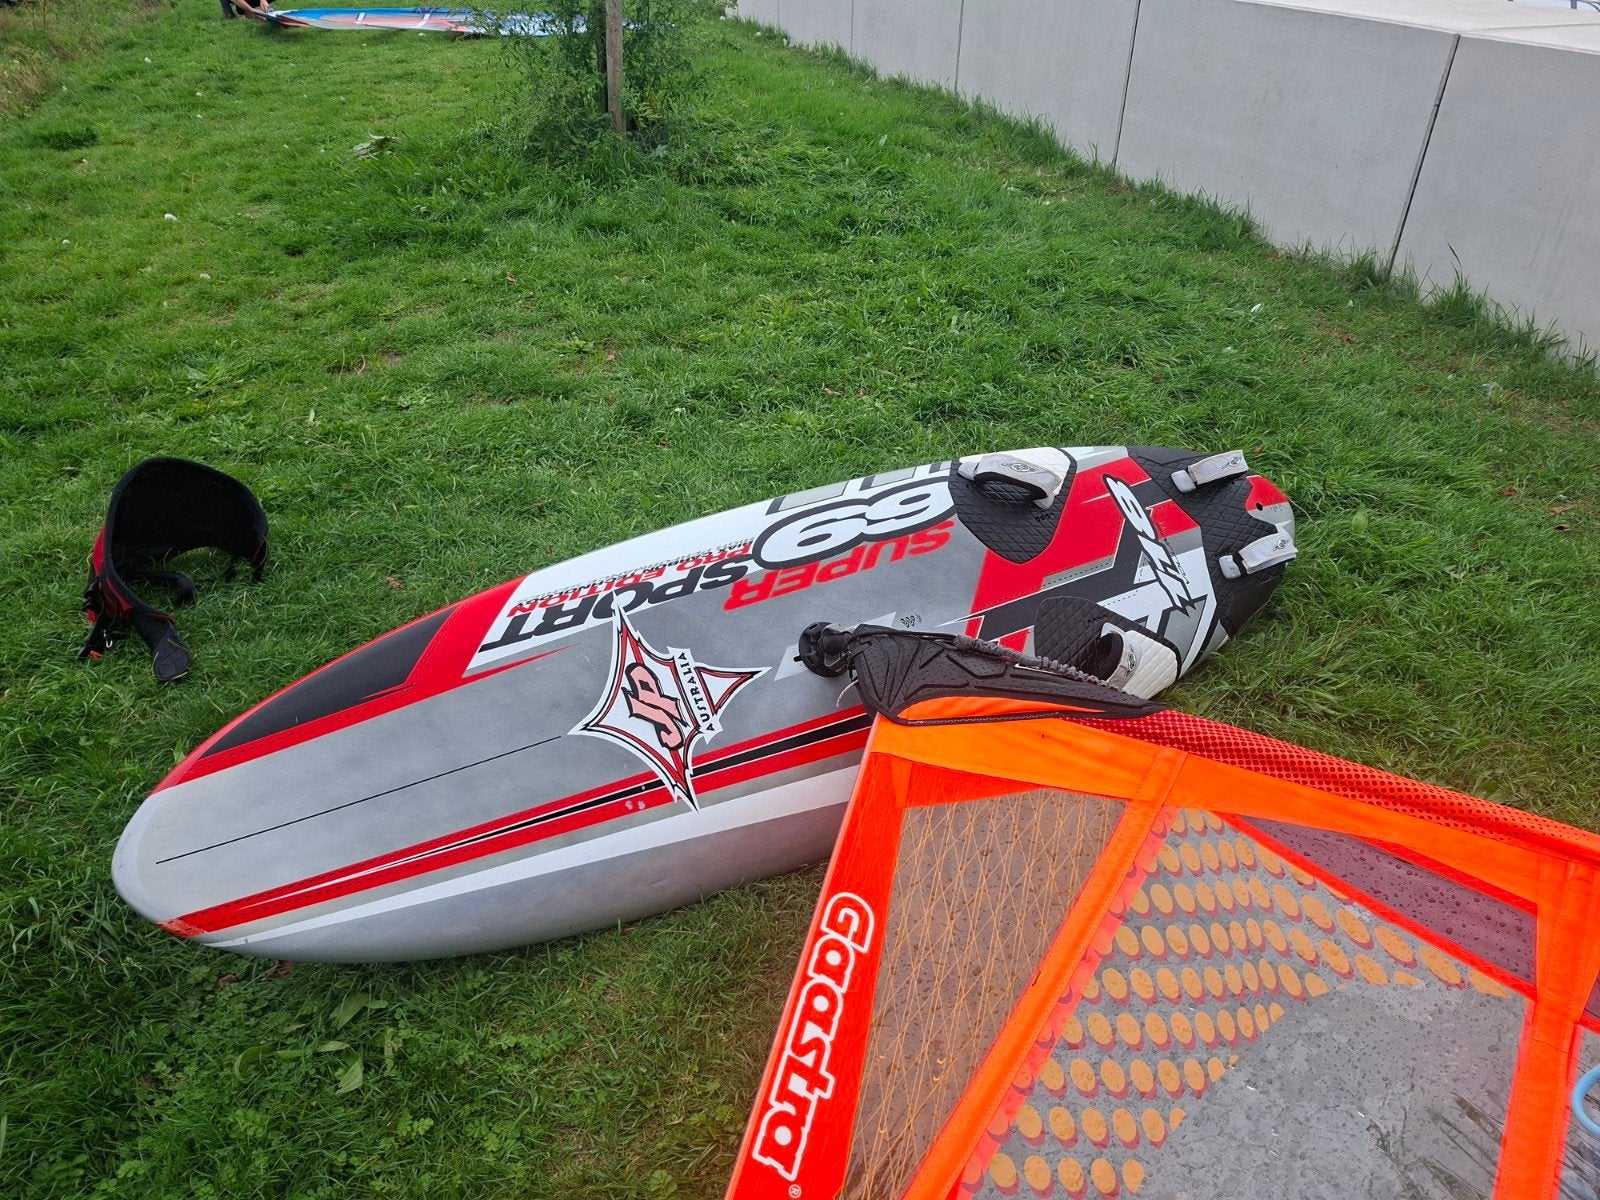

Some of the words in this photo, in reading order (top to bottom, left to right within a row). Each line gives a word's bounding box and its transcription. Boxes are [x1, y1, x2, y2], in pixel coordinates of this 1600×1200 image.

[641, 551, 712, 574] CARBON
[675, 544, 752, 571] PRO
[723, 519, 955, 611] SUPER
[753, 476, 957, 570] 69
[1104, 475, 1192, 613] 118
[479, 555, 756, 653] SPORT
[506, 566, 666, 618] EDITION
[515, 571, 637, 607] TECHNOLOGY
[679, 652, 715, 731] AUSTRALIA
[752, 892, 874, 1182] Gaastra
